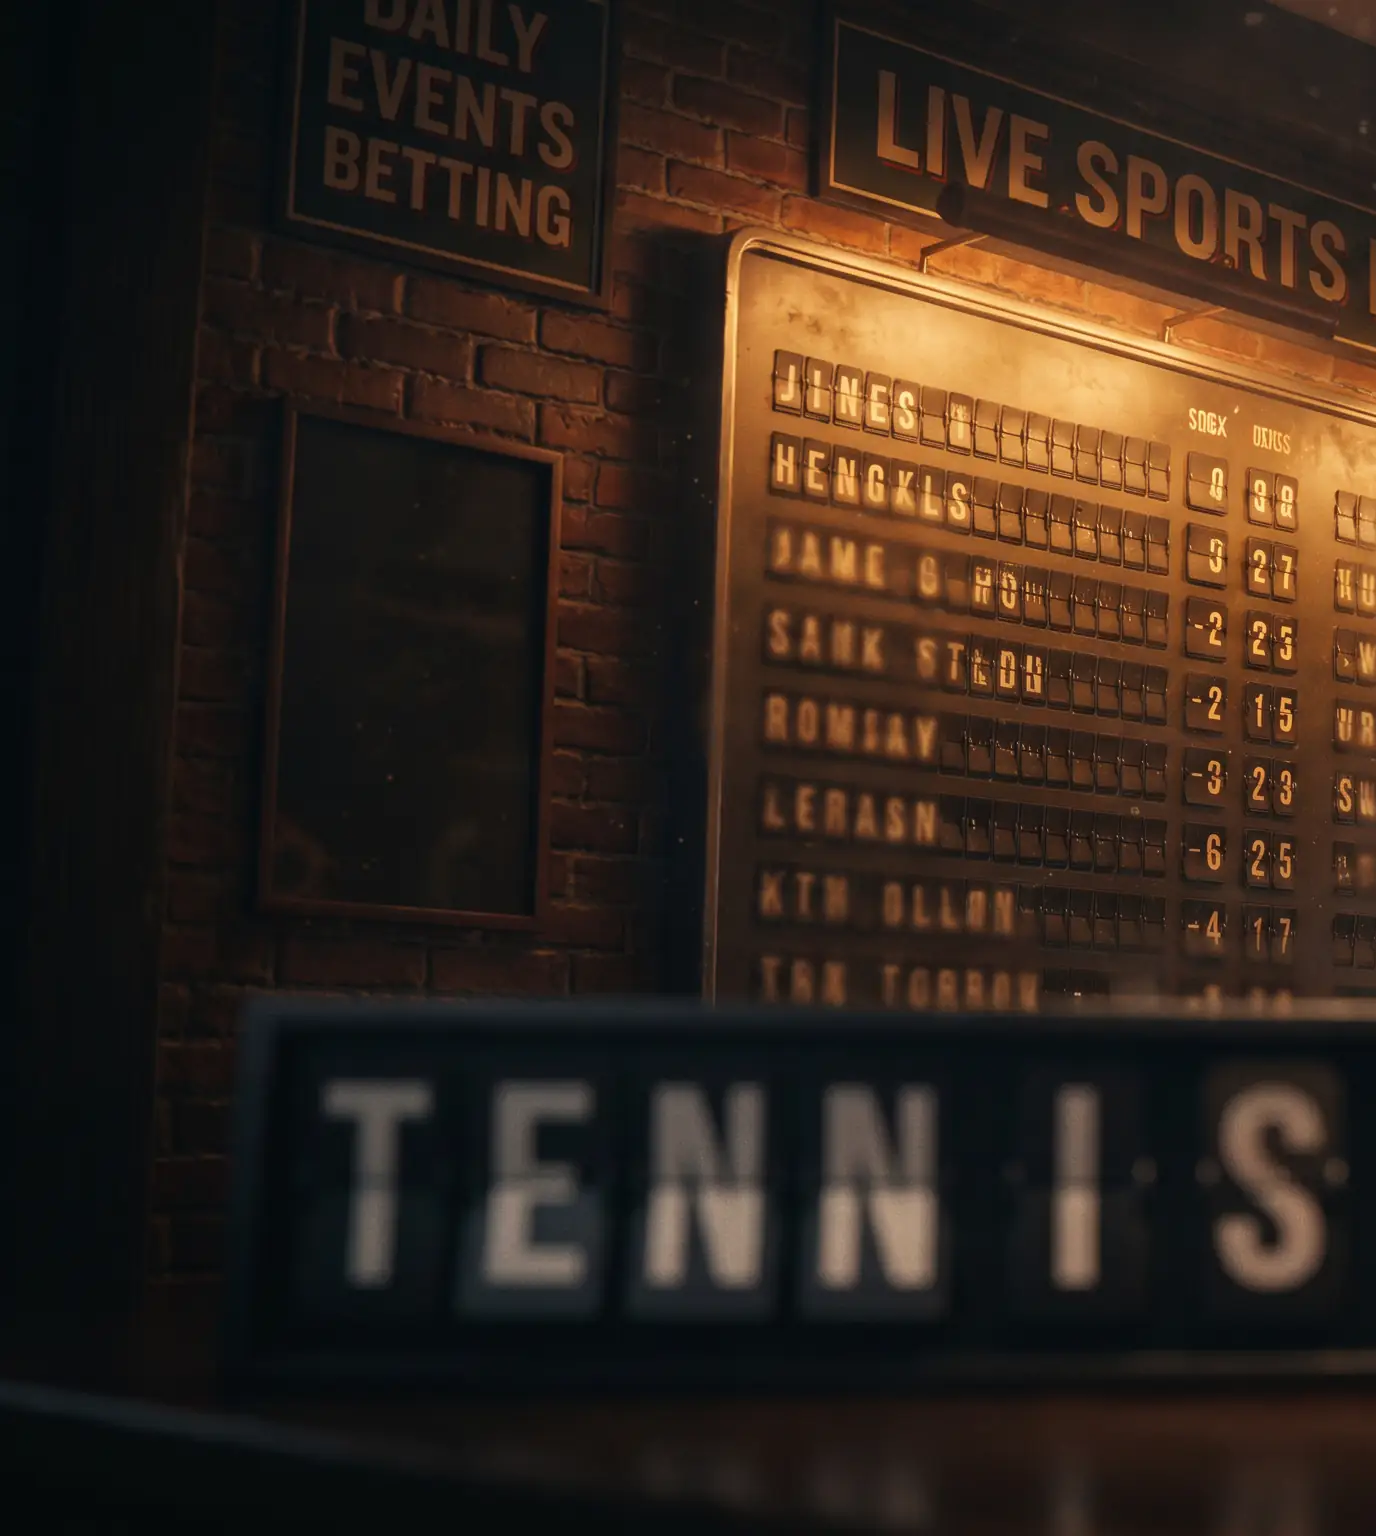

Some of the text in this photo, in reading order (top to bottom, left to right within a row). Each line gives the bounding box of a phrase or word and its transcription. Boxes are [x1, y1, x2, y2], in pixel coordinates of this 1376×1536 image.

[327, 36, 576, 170] EVENTS
[322, 125, 574, 249] BETTING
[876, 68, 1050, 208] LIVE
[1075, 139, 1347, 303] SPORTS
[779, 364, 914, 430] JINES
[775, 443, 967, 521] HENGKLS
[1253, 549, 1293, 590] 27
[1194, 611, 1223, 646] -2
[1252, 620, 1293, 661] 25
[1191, 686, 1222, 721] -2
[1254, 693, 1293, 733] 15
[1191, 760, 1222, 795] -3
[1252, 766, 1292, 806] 23
[1188, 833, 1221, 871] -6
[1251, 839, 1292, 879] 25
[1187, 911, 1221, 945] -4
[1253, 917, 1291, 954] 17
[322, 1079, 1329, 1292] TENNIS
